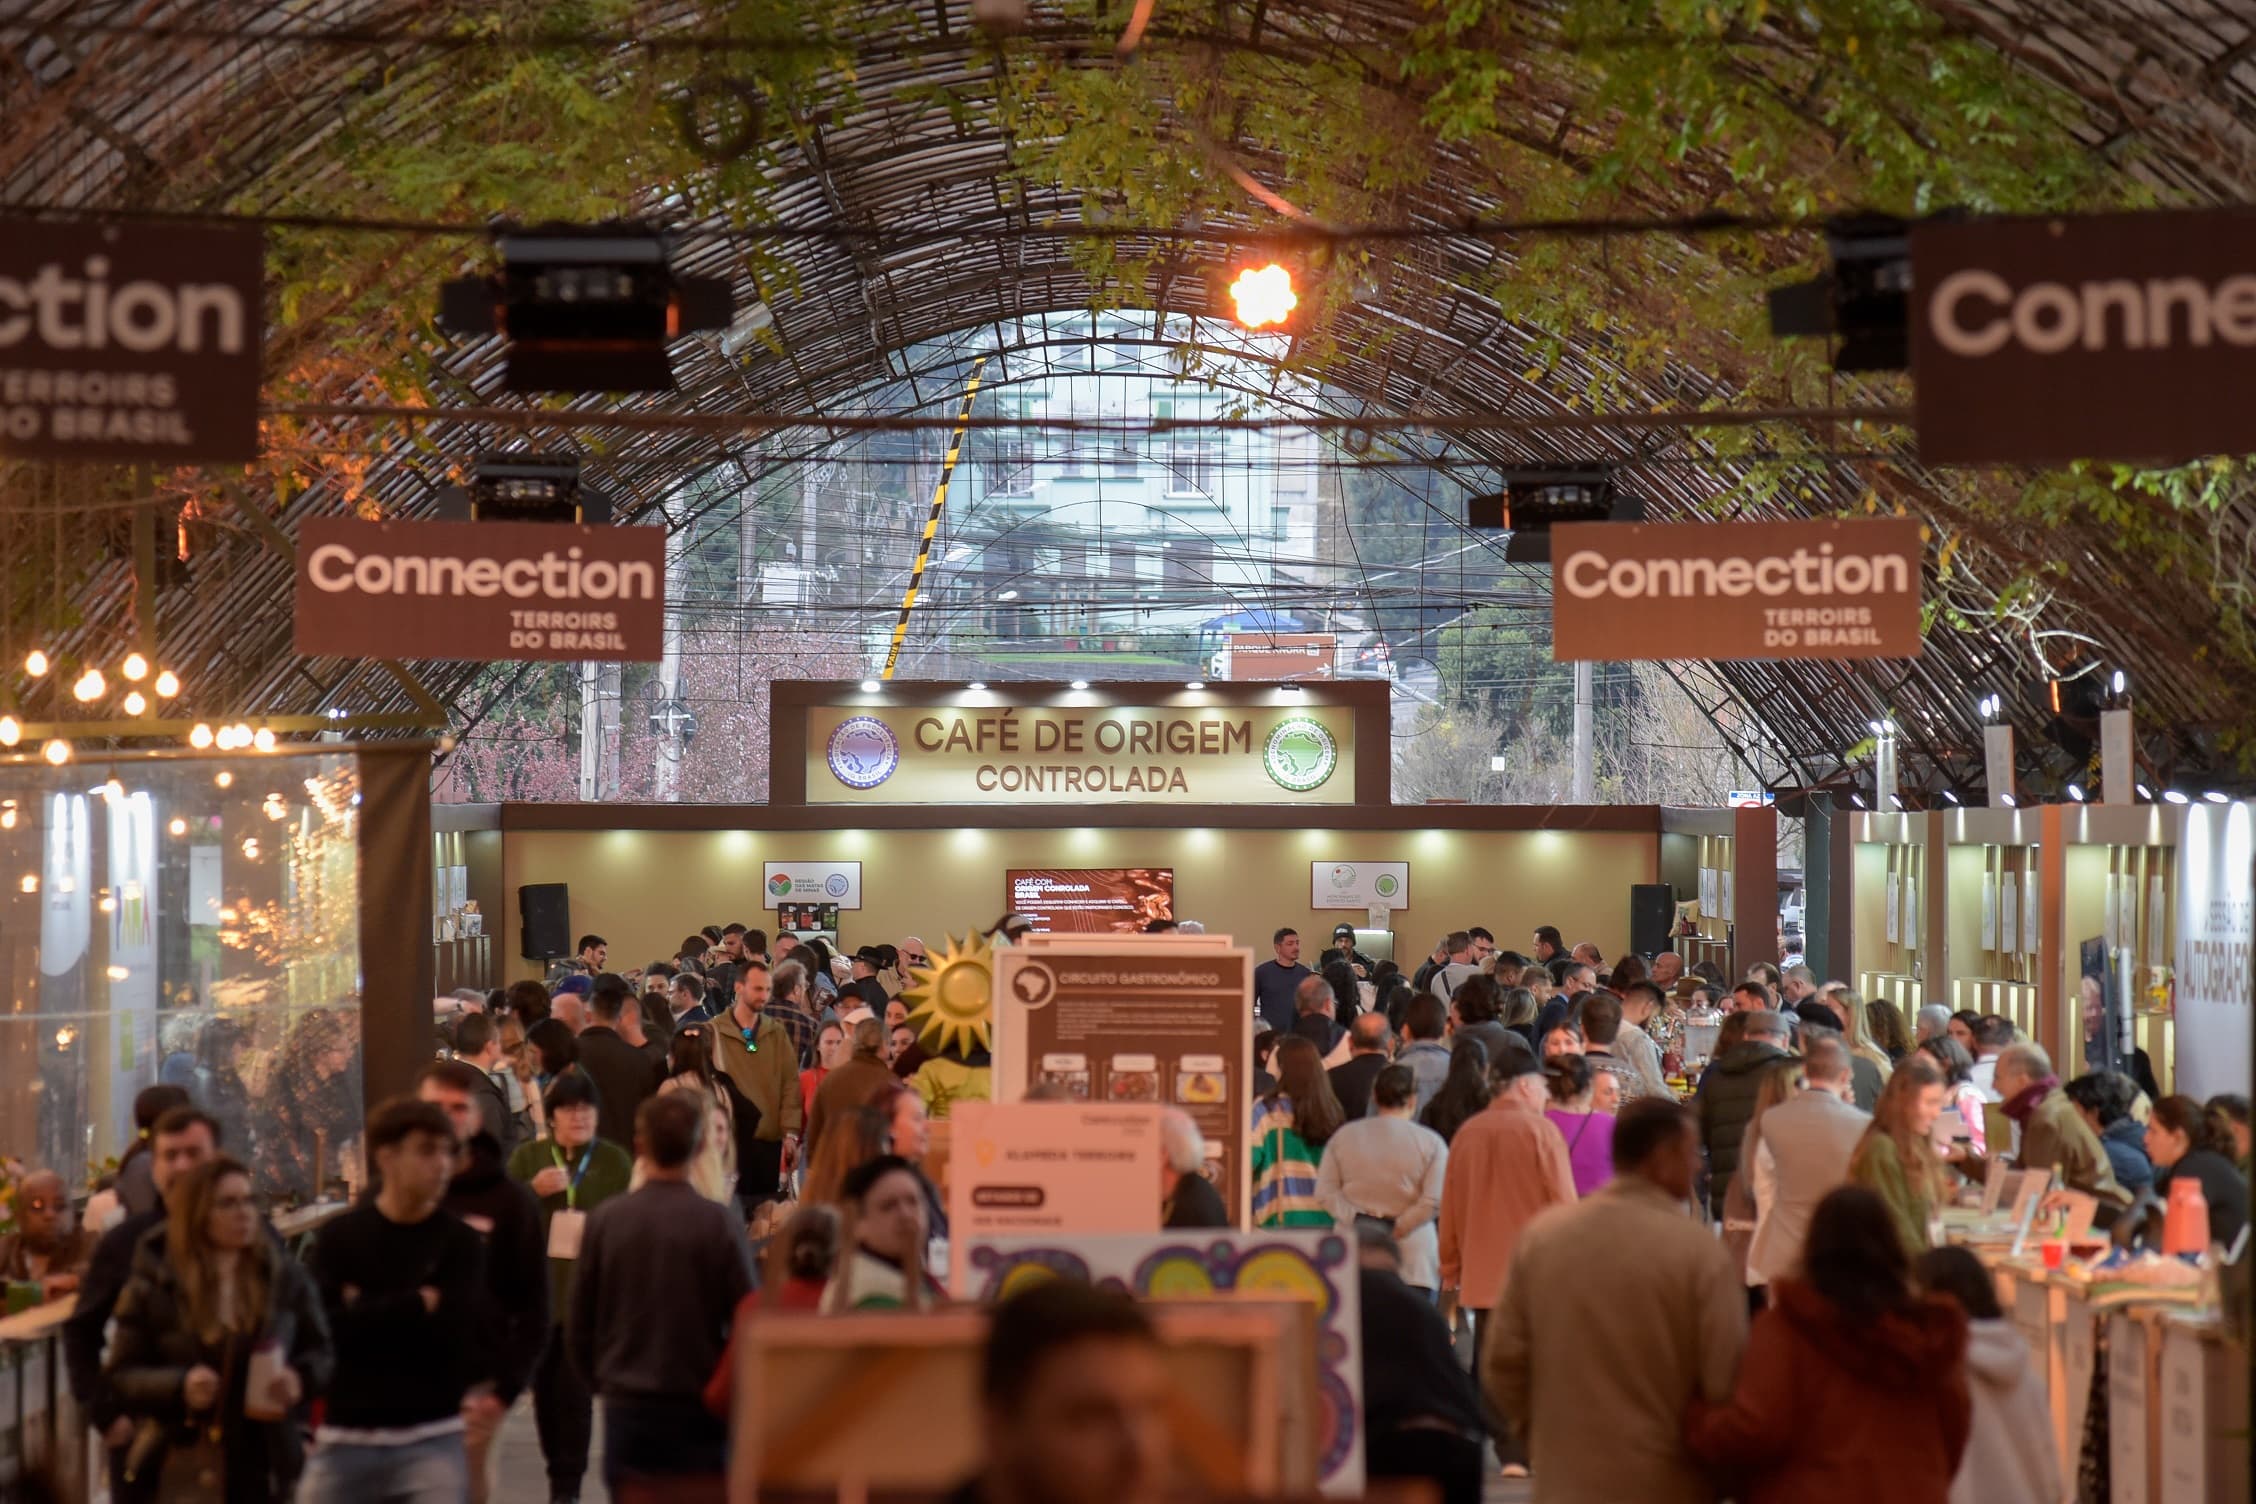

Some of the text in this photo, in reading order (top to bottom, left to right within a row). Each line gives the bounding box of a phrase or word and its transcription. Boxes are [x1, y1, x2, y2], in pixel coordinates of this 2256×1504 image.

[51, 408, 194, 445] BRASIL
[307, 543, 655, 600] Connection
[1563, 542, 1908, 599] Connection
[510, 610, 617, 630] TERROIRS
[1764, 607, 1872, 627] TERROIRS
[510, 631, 627, 650] DO BRASIL
[1764, 627, 1882, 647] DO BRASIL
[914, 707, 1254, 755] CAFÉ DE ORIGEM
[975, 764, 1189, 793] CONTROLADA
[1014, 877, 1035, 886] CAFÉ
[1058, 972, 1117, 985] CIRCUITO
